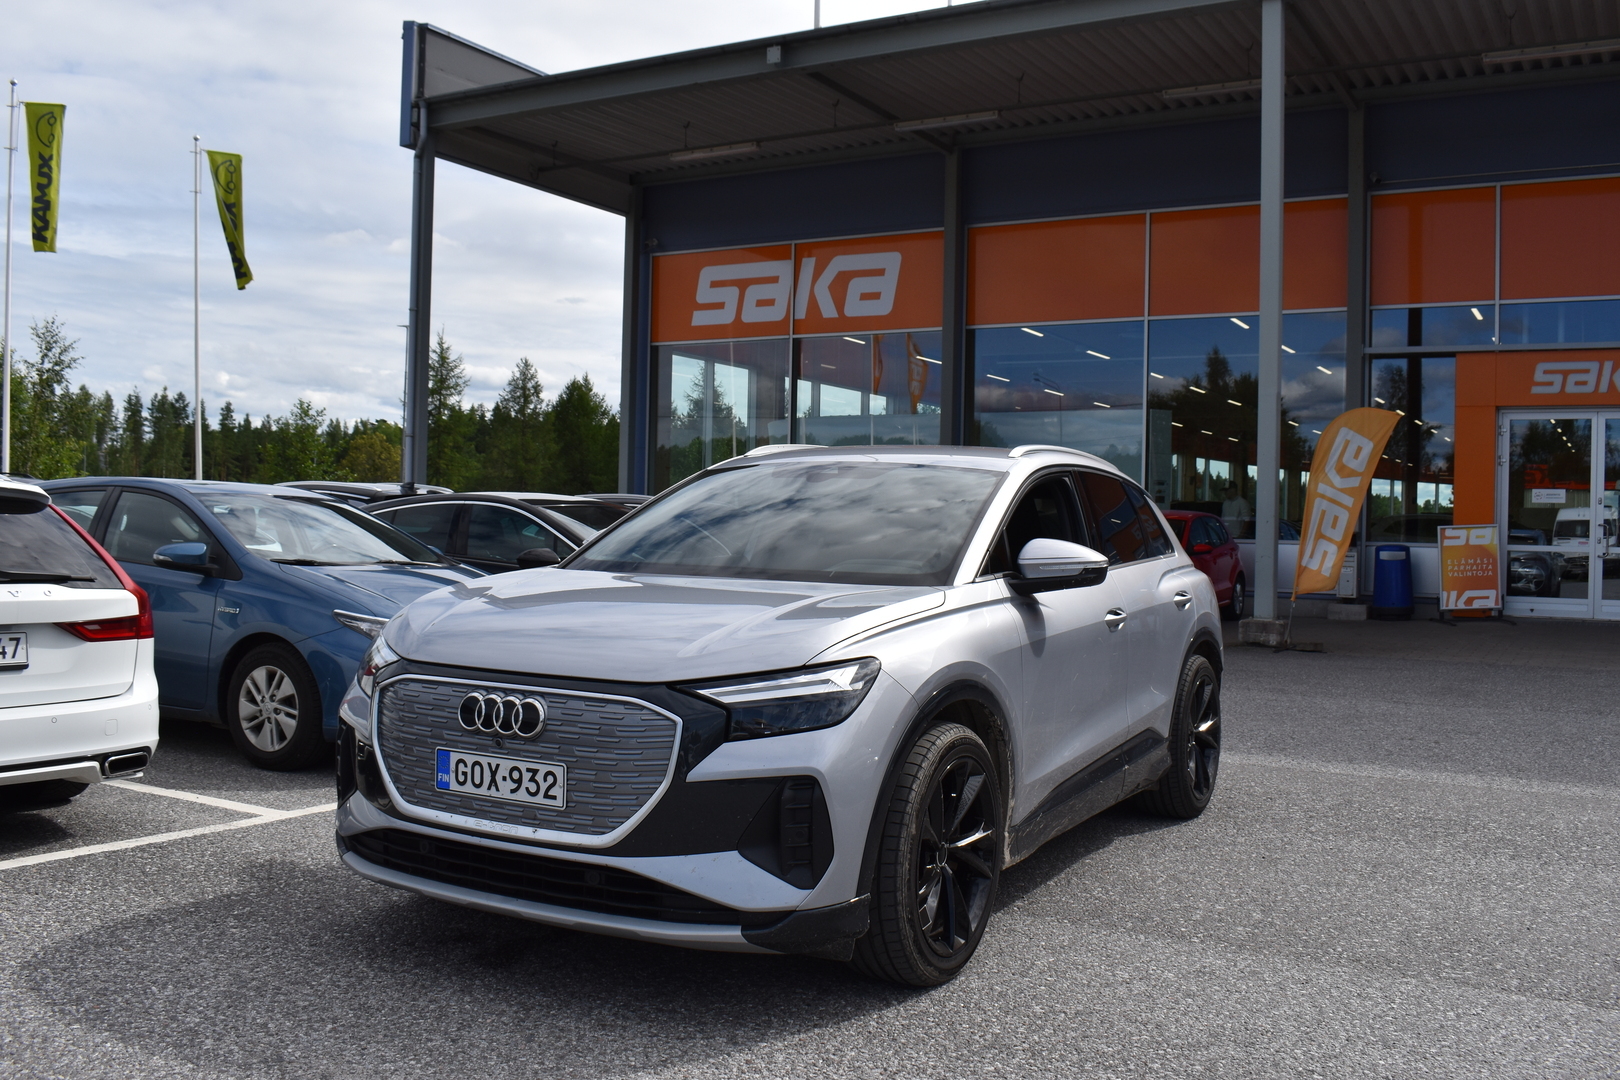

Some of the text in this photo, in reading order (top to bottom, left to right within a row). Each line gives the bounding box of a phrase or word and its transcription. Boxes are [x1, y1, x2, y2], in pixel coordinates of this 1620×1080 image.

[31, 151, 54, 244] KAMUX
[1447, 557, 1493, 565] ELÄMÄSI
[438, 772, 450, 783] FIN
[455, 758, 558, 801] GOX-932
[474, 819, 519, 835] e-tron
